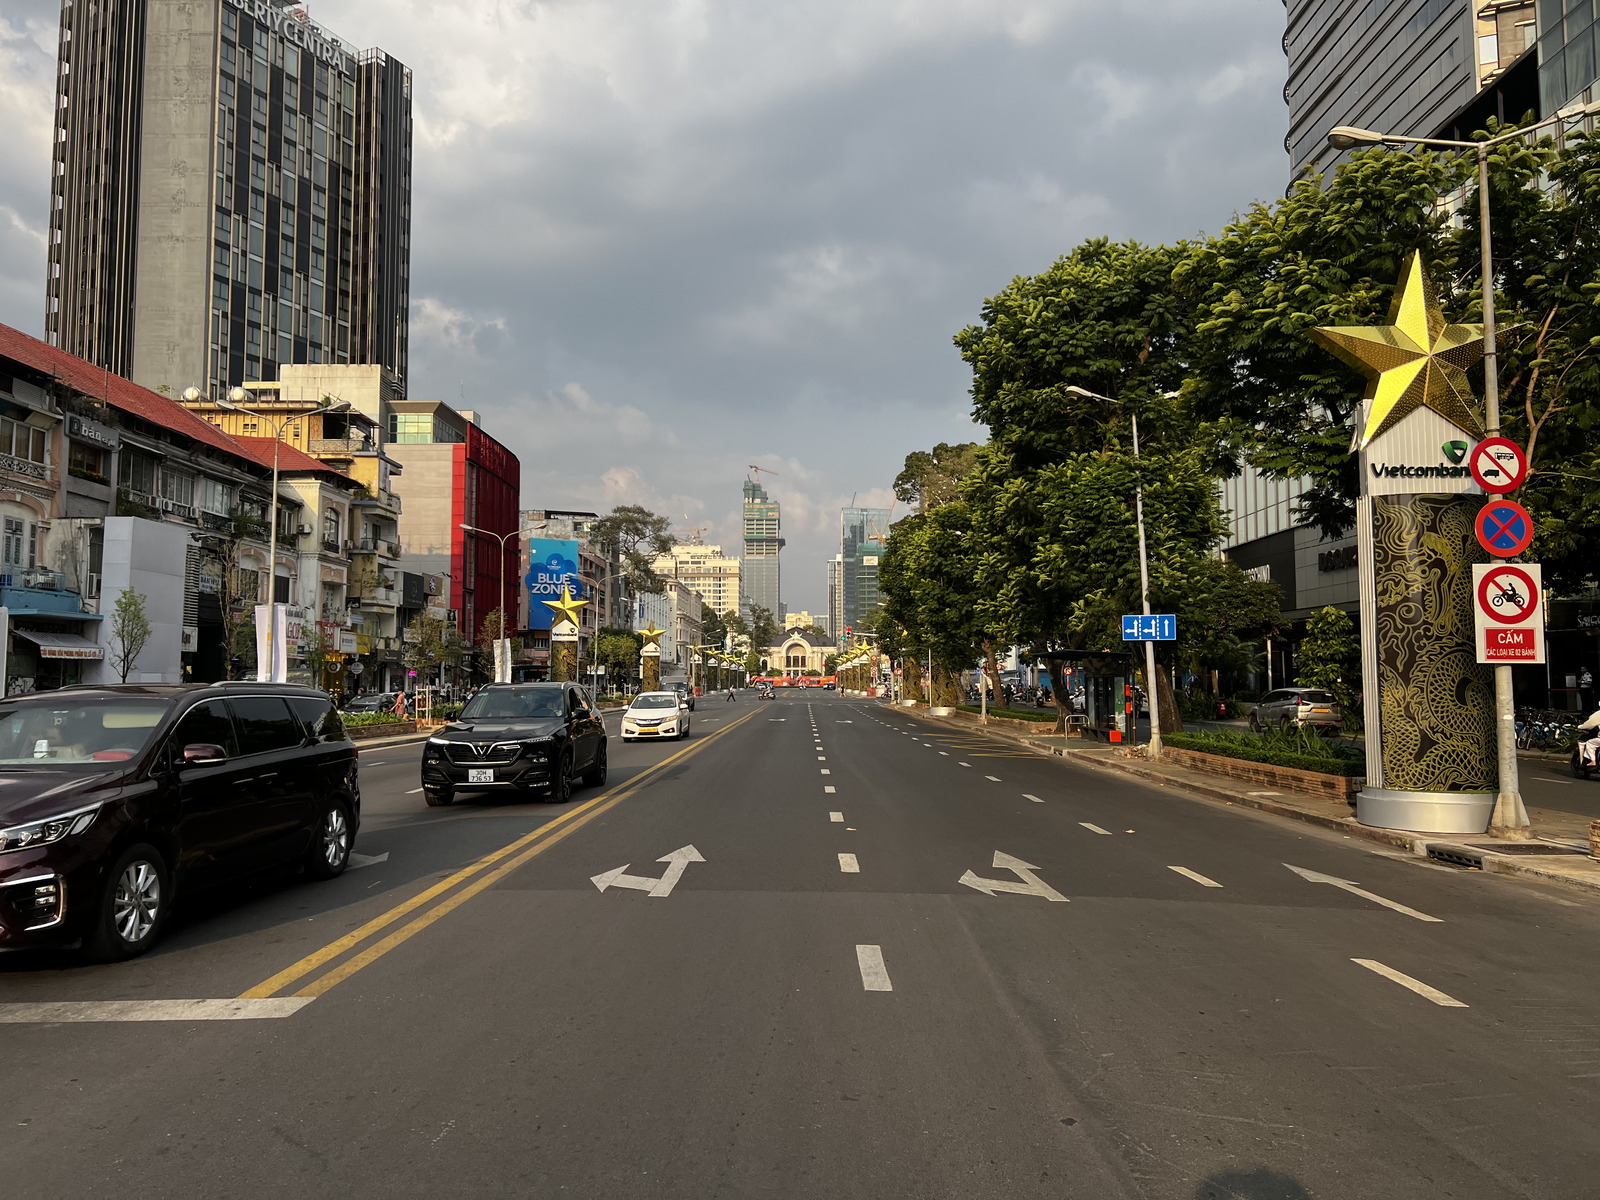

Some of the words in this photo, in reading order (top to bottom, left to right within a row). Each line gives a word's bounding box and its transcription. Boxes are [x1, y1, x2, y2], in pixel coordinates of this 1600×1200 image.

[283, 19, 350, 75] CENTRAL
[537, 572, 571, 584] BLUE
[1497, 629, 1523, 644] CẤM
[1486, 647, 1496, 656] CÁC
[1497, 648, 1508, 658] LOẠI
[1522, 647, 1535, 656] BÁNH
